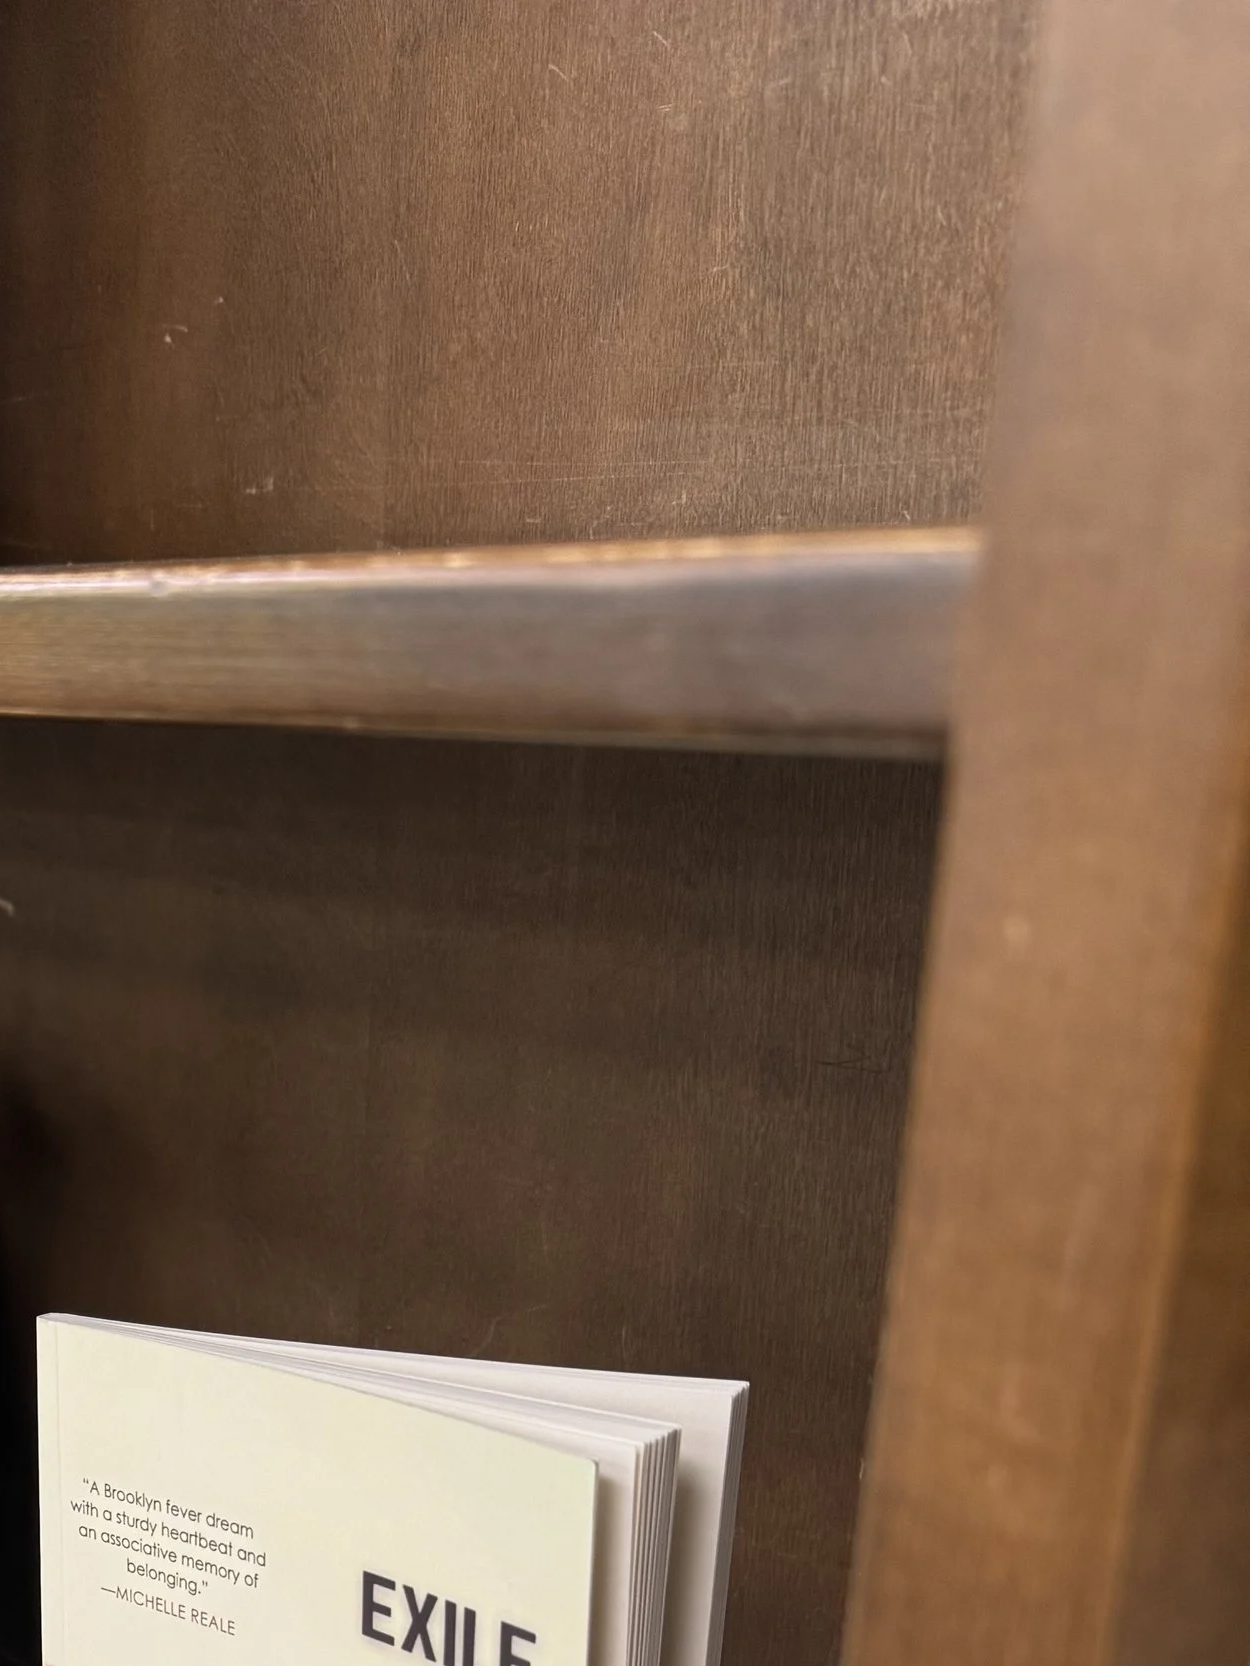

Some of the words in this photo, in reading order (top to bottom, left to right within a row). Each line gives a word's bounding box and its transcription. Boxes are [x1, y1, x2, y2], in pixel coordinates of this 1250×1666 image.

[70, 1500, 99, 1518] with
[103, 1508, 112, 1521] a
[116, 1511, 157, 1537] sturdy
[161, 1522, 233, 1557] heartbeat
[237, 1549, 266, 1567] and
[104, 1483, 162, 1513] Brooklyn
[166, 1499, 202, 1524] fever
[206, 1513, 254, 1540] dream
[79, 1525, 97, 1541] an
[101, 1531, 178, 1564] associative
[182, 1554, 240, 1586] memory
[244, 1573, 259, 1589] of
[191, 1608, 236, 1636] REALE
